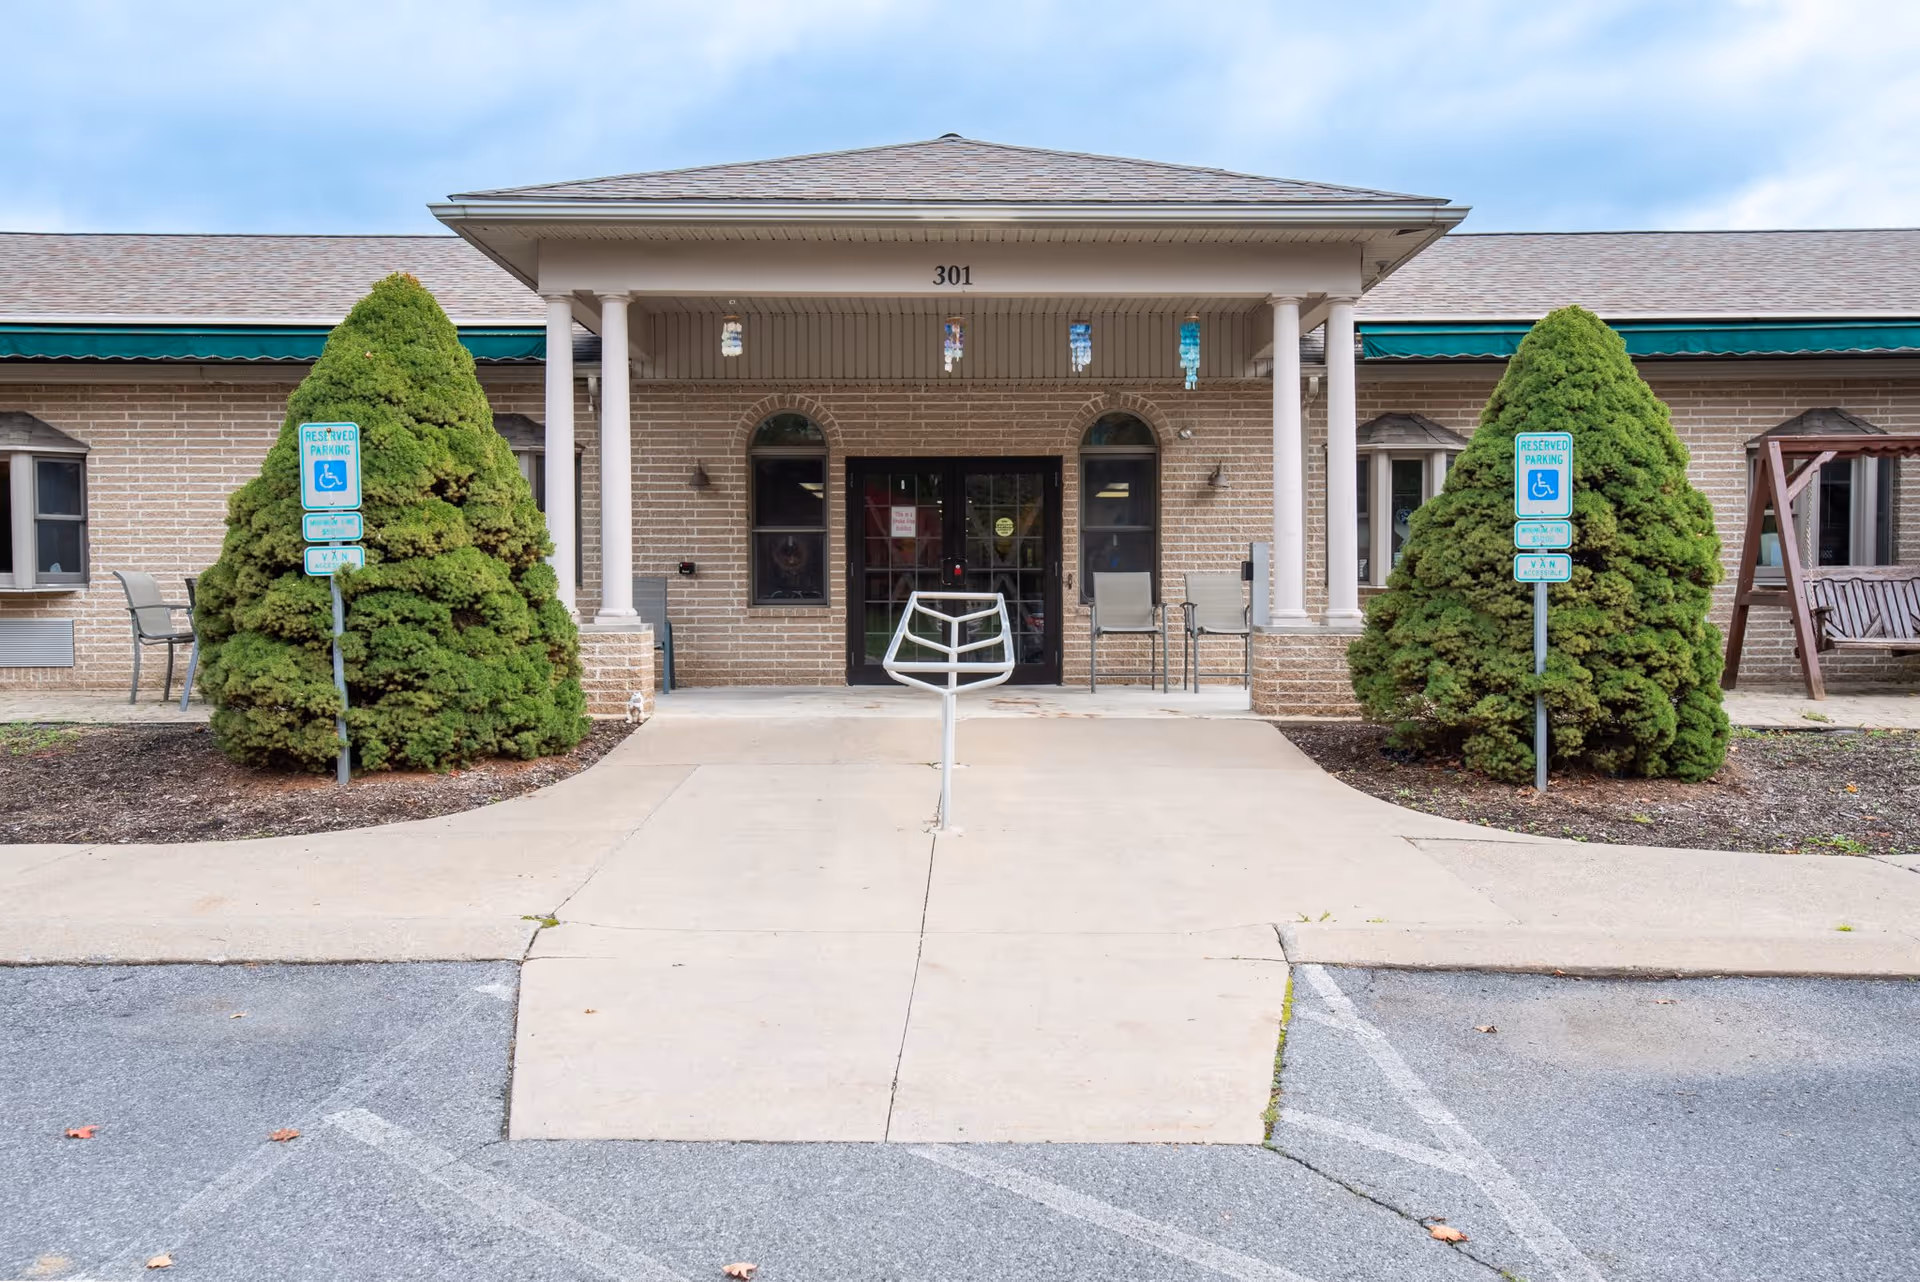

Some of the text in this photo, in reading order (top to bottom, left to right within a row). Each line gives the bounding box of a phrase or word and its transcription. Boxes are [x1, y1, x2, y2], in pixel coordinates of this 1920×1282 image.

[932, 264, 973, 286] 301
[304, 430, 355, 442] RESERVED
[310, 445, 351, 457] PARKING
[1520, 440, 1568, 451] RESERVED
[1524, 454, 1563, 465] PARKING
[321, 552, 348, 561] VAN
[1531, 560, 1556, 568] VAN
